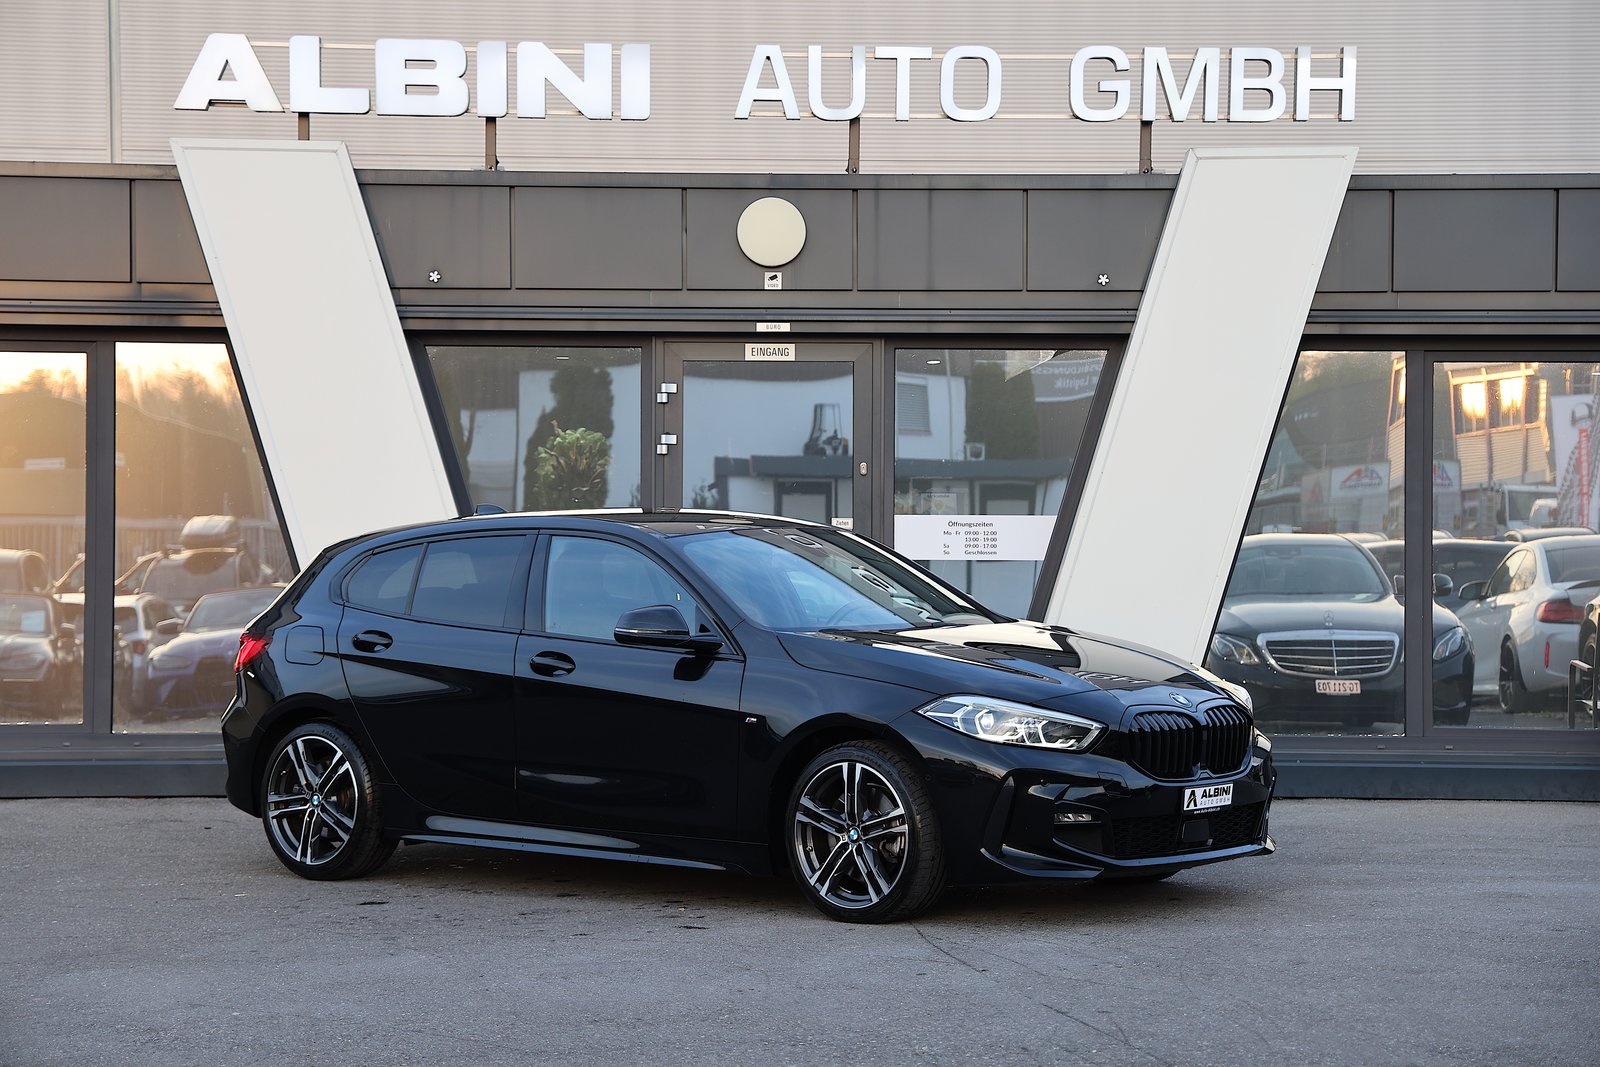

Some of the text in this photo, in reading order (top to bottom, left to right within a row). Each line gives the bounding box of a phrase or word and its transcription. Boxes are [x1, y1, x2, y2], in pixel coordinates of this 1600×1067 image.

[173, 32, 1357, 122] ALBINI AUTO GMBH
[751, 347, 790, 357] EINGANG
[948, 520, 994, 528] Öffnungszeiten
[1201, 786, 1231, 799] ALBINI
